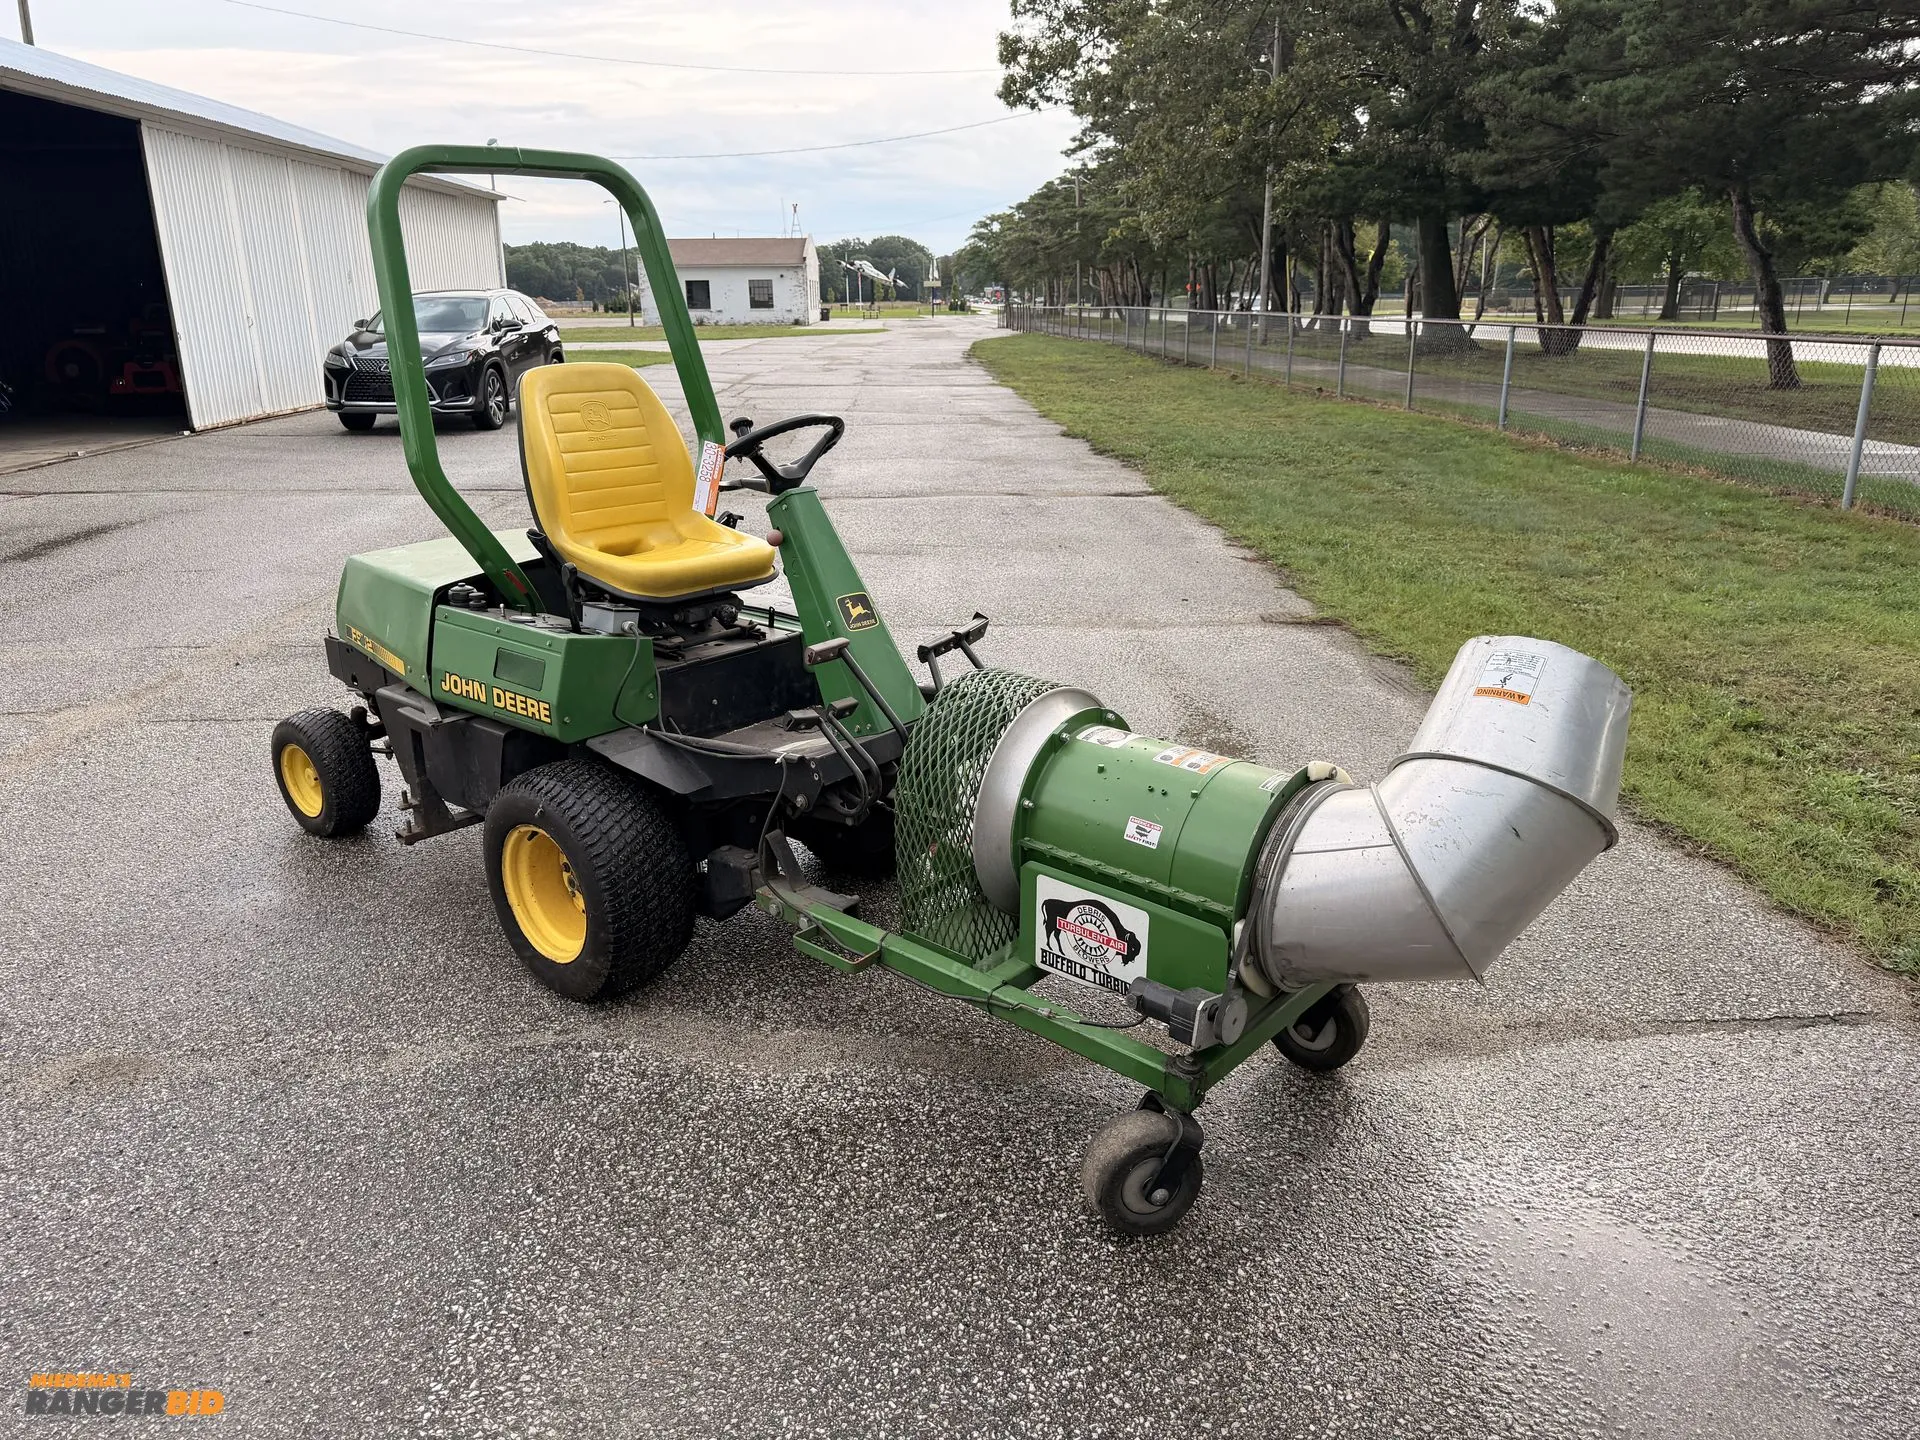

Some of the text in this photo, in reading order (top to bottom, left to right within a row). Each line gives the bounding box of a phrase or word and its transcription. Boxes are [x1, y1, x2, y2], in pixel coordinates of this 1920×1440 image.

[441, 671, 552, 725] JOHN DEERE
[1477, 688, 1517, 700] WARNING
[1077, 906, 1106, 922] DEBRIS
[1059, 919, 1125, 952] TURBULENT AIR
[1072, 944, 1110, 965] BLOWERS
[1040, 948, 1131, 996] BUFFALO TURBIN
